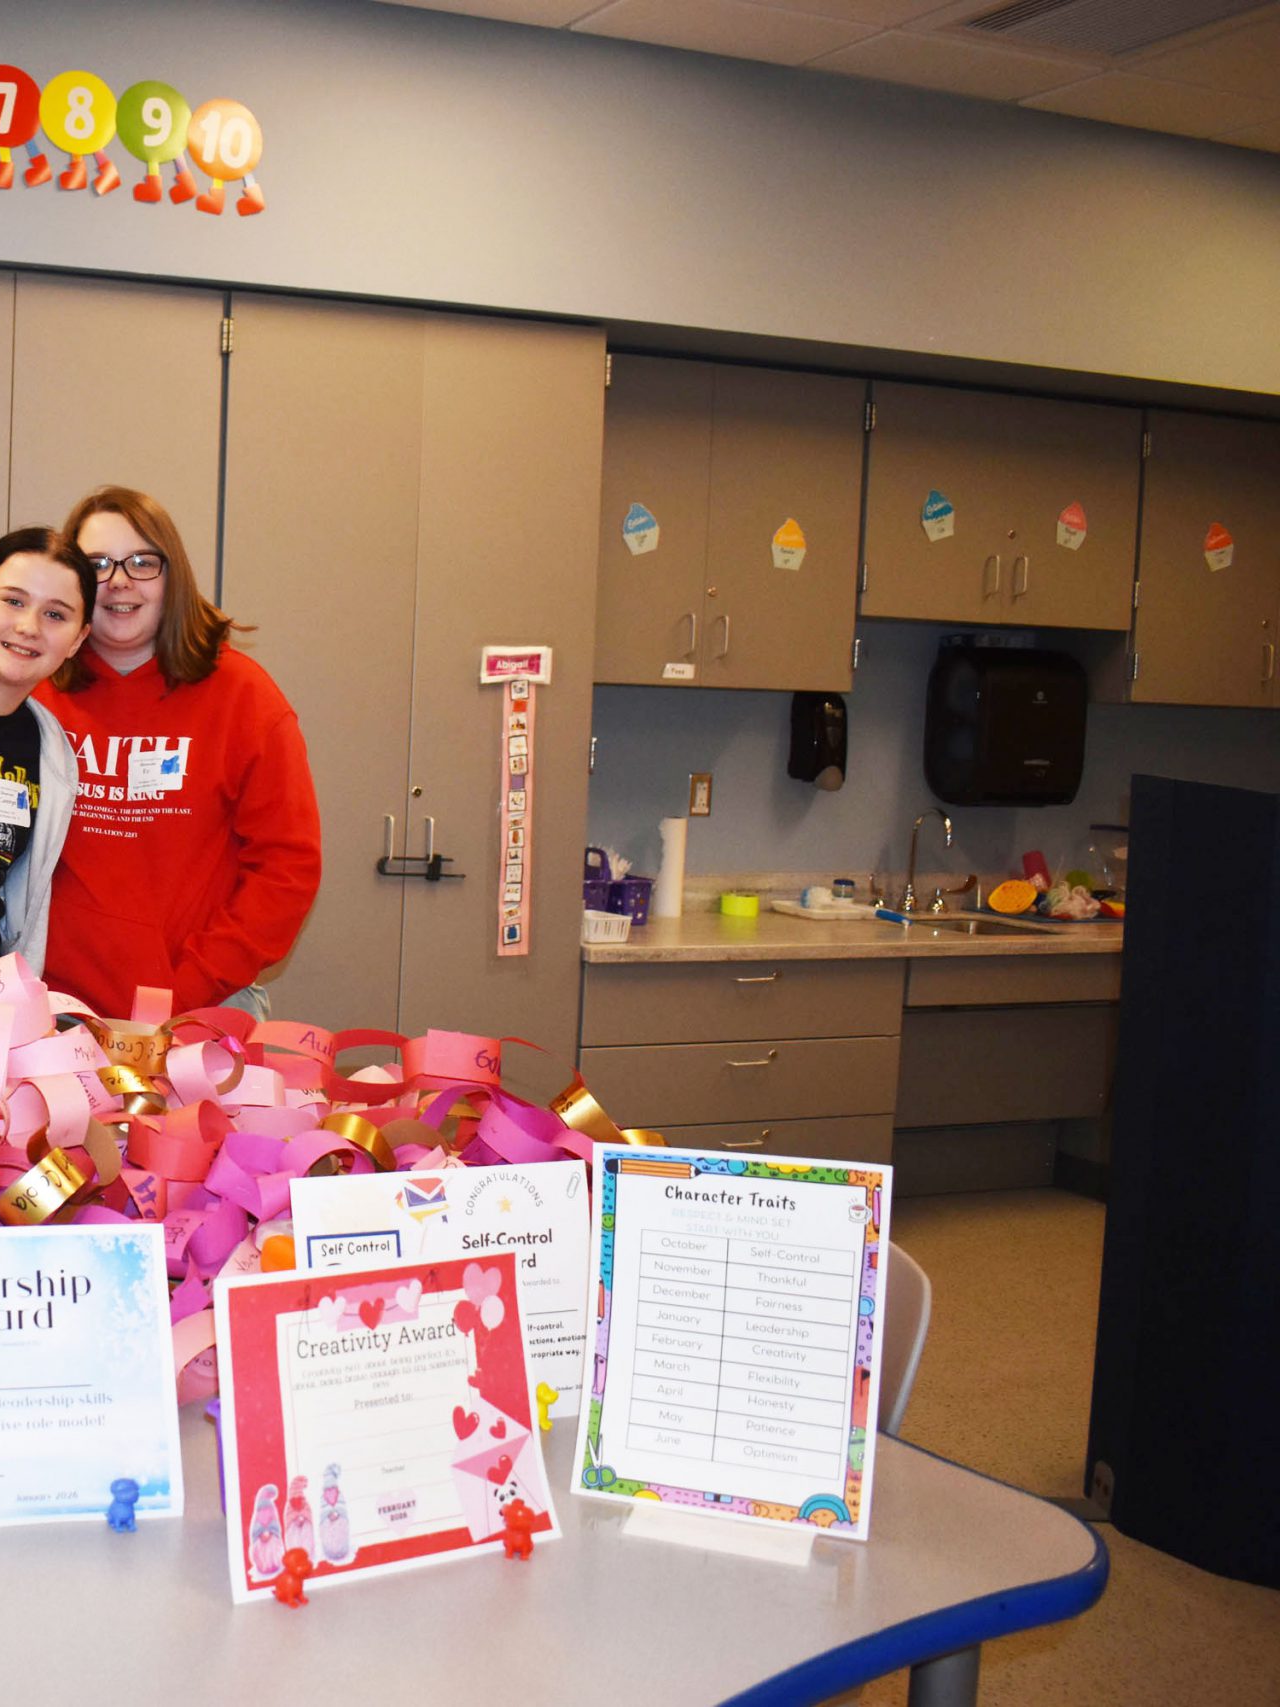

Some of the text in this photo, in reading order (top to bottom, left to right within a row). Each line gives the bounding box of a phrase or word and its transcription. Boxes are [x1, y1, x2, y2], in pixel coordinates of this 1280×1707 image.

[66, 86, 95, 136] 8
[141, 97, 173, 146] 9
[198, 116, 251, 168] 10
[64, 730, 193, 776] AITH
[77, 781, 106, 799] SUS
[108, 786, 124, 801] IS
[79, 811, 115, 821] BEGINNING
[83, 826, 124, 836] REVELATION
[465, 1172, 544, 1216] CONGRATULATIONS
[665, 1185, 797, 1211] Character Traits
[737, 1214, 767, 1226] MIND
[771, 1218, 793, 1228] SET
[462, 1229, 553, 1250] Self-Control
[723, 1226, 752, 1238] WITH
[754, 1230, 780, 1241] YOU
[322, 1240, 390, 1257] Self Control
[661, 1237, 707, 1252] October
[750, 1247, 821, 1263] Self-Control
[654, 1260, 712, 1277] November
[757, 1272, 807, 1287] Thankful
[652, 1284, 711, 1300] December
[755, 1297, 803, 1312] Fairness
[656, 1311, 701, 1325] January
[527, 1322, 564, 1332] lf-control.
[745, 1321, 810, 1339] Leadership
[297, 1321, 456, 1359] Creativity Award
[557, 1334, 587, 1344] emotion
[651, 1334, 703, 1350] February
[752, 1345, 806, 1363] Creativity
[654, 1359, 690, 1373] March
[748, 1371, 800, 1388] Flexibility
[78, 1391, 114, 1406] skills
[657, 1384, 684, 1398] April
[354, 1394, 399, 1410] Presented
[747, 1395, 795, 1412] Honesty
[26, 1416, 53, 1431] role
[58, 1413, 106, 1429] model!
[659, 1410, 684, 1423] May
[746, 1421, 796, 1437] Patience
[654, 1433, 681, 1446] June
[743, 1446, 798, 1464] Optimism
[377, 1499, 416, 1516] FEBRUARY
